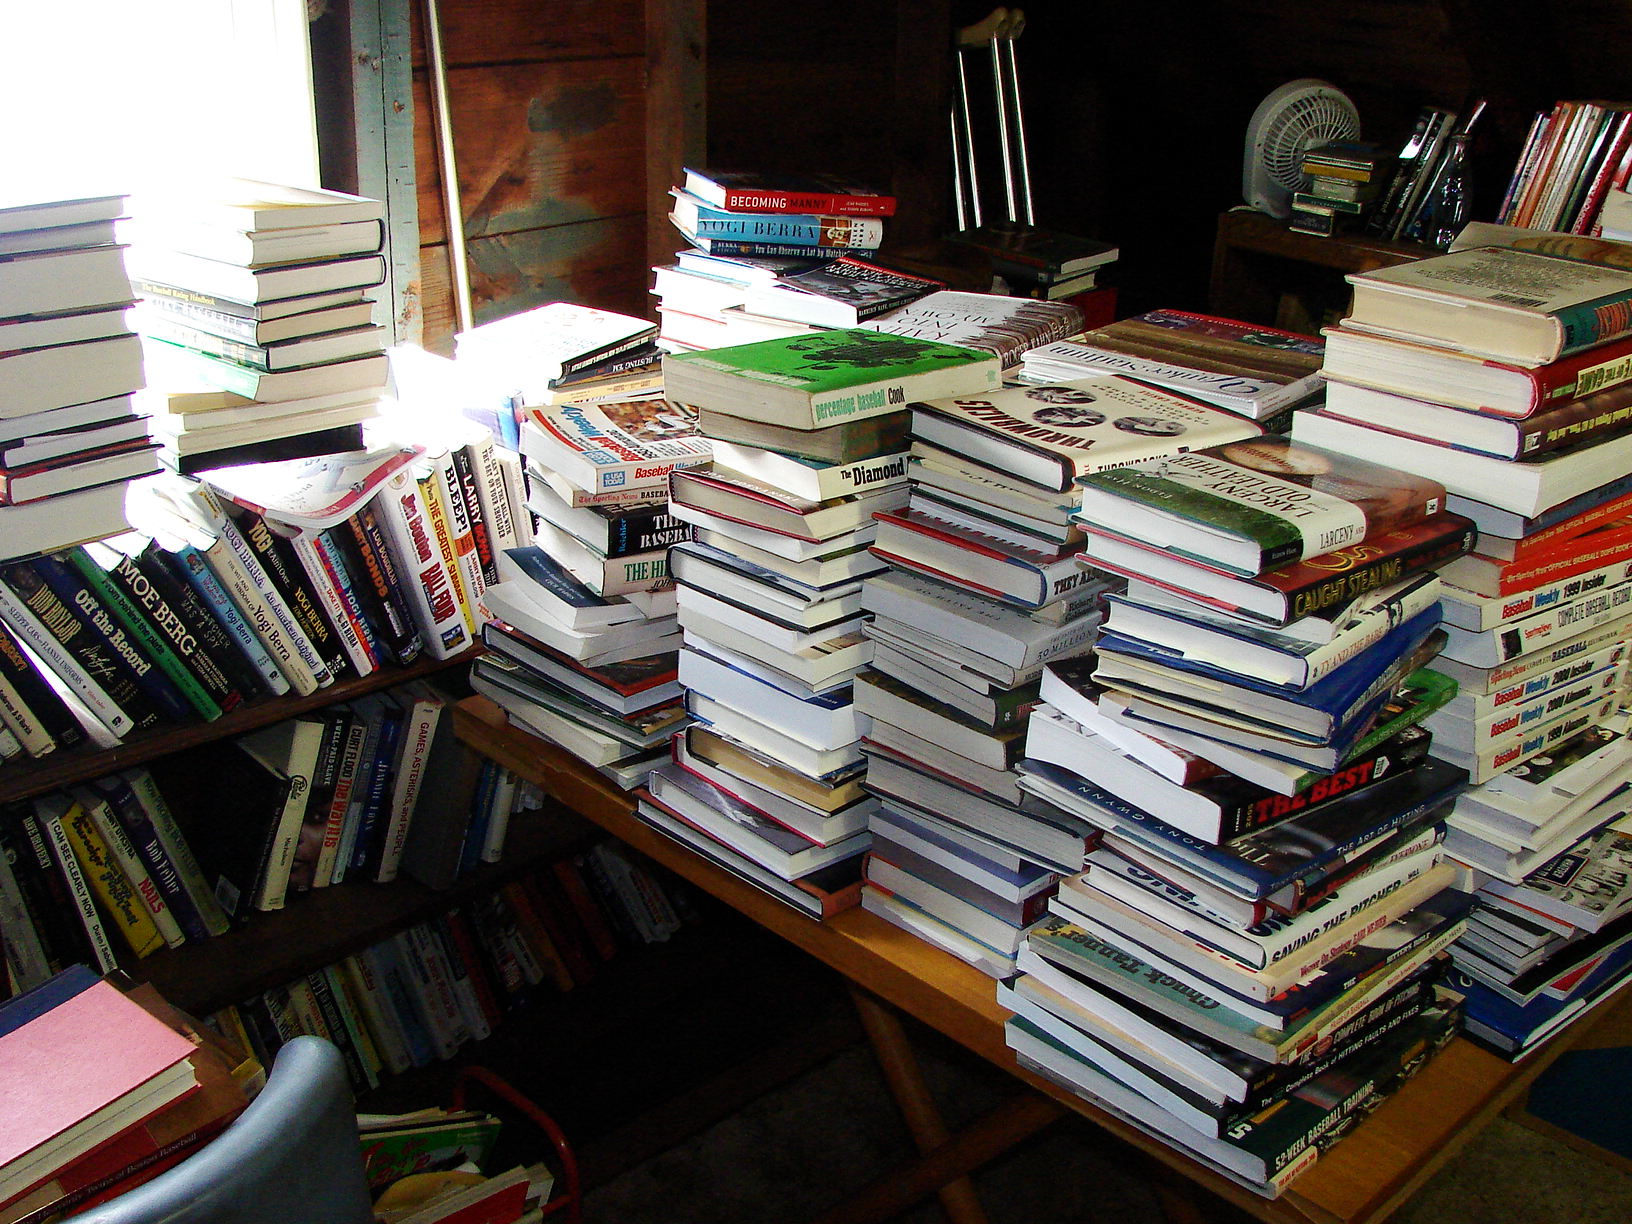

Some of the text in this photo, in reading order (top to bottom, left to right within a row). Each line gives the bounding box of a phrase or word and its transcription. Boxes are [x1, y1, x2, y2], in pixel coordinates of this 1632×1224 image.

[731, 195, 827, 209] BECOMING MANNY
[700, 220, 815, 239] YOGI BERRA
[755, 245, 765, 254] You
[767, 245, 777, 255] Can
[625, 356, 653, 370] BUSTING
[1049, 344, 1262, 395] Yankee Stadium
[815, 386, 905, 421] percentage baseball Cook
[953, 400, 1096, 451] THROWBACKS
[841, 458, 905, 487] The Diamond
[1168, 455, 1312, 501] OLD LEATHER
[444, 466, 468, 534] BLEEP!
[461, 474, 492, 567] LARRY BOWA
[653, 513, 684, 530] THE
[1204, 481, 1315, 519] LARCENY
[372, 527, 382, 544] LOU
[401, 492, 433, 564] Jim Bouton
[1320, 524, 1355, 549] LARCENY
[362, 546, 388, 597] BONDS
[428, 499, 465, 605] THE GREATEST SUMMER
[470, 554, 485, 596] LARRY BOWA
[624, 561, 648, 582] THE
[117, 558, 160, 608] MOE
[153, 605, 197, 656] BERG
[222, 519, 319, 670] YOGI BERRA An American Original
[419, 561, 456, 625] BALL FOUR
[1053, 576, 1078, 596] THEY
[1295, 557, 1401, 618] CAUGHT STEALING
[1502, 596, 1534, 619] Baseball
[1535, 589, 1560, 608] Weekly
[1581, 574, 1606, 592] Insider
[27, 583, 82, 645] DON BAYLOR
[74, 588, 93, 612] Off
[96, 611, 113, 635] the
[109, 629, 151, 677] Record
[102, 579, 165, 655] From behind the plate
[225, 606, 252, 645] Yogi Berra
[253, 605, 271, 631] Yogi
[269, 627, 290, 662] Berra
[292, 605, 302, 618] TOM
[293, 585, 310, 608] YOGI
[306, 605, 329, 643] BERRA
[345, 588, 376, 649] YOGI BERRA
[1494, 684, 1525, 707] Baseball
[1525, 676, 1549, 695] Weekly
[1570, 660, 1594, 678] Insider
[350, 728, 364, 750] CURT
[417, 722, 431, 757] GAMES,
[1490, 713, 1520, 738] Baseball
[1520, 705, 1544, 724] Weekly
[343, 750, 359, 780] FLOOD
[1493, 744, 1521, 769] Baseball
[1521, 735, 1544, 755] Weekly
[331, 801, 348, 826] Way
[338, 779, 352, 802] The
[1078, 785, 1146, 821] GWYNN
[1254, 794, 1306, 823] THE
[1311, 759, 1375, 802] BEST
[400, 806, 410, 822] and
[1336, 804, 1425, 856] THE ART OF HITTING
[67, 816, 108, 870] Durocher
[1155, 824, 1206, 851] TONY
[54, 825, 65, 843] CAN
[60, 843, 72, 860] SEE
[67, 861, 88, 899] CLEARLY
[81, 898, 95, 918] NOW
[114, 826, 136, 860] DYKSTRA
[138, 878, 165, 914] NAILS
[144, 839, 181, 896] Bob Feller
[1272, 928, 1320, 964] SAVING
[1320, 911, 1347, 935] THE
[1349, 879, 1401, 919] PITCHER
[1145, 965, 1221, 1010] Chuck
[1285, 1073, 1314, 1094] Complete
[1315, 1063, 1331, 1076] Book
[1337, 1041, 1364, 1062] HITTING
[1364, 1024, 1387, 1044] FAULTS
[1387, 1015, 1402, 1031] AND
[1401, 1005, 1420, 1022] FIXES
[1275, 1079, 1375, 1171] 52-WEEK BASEBALL TRAINING
